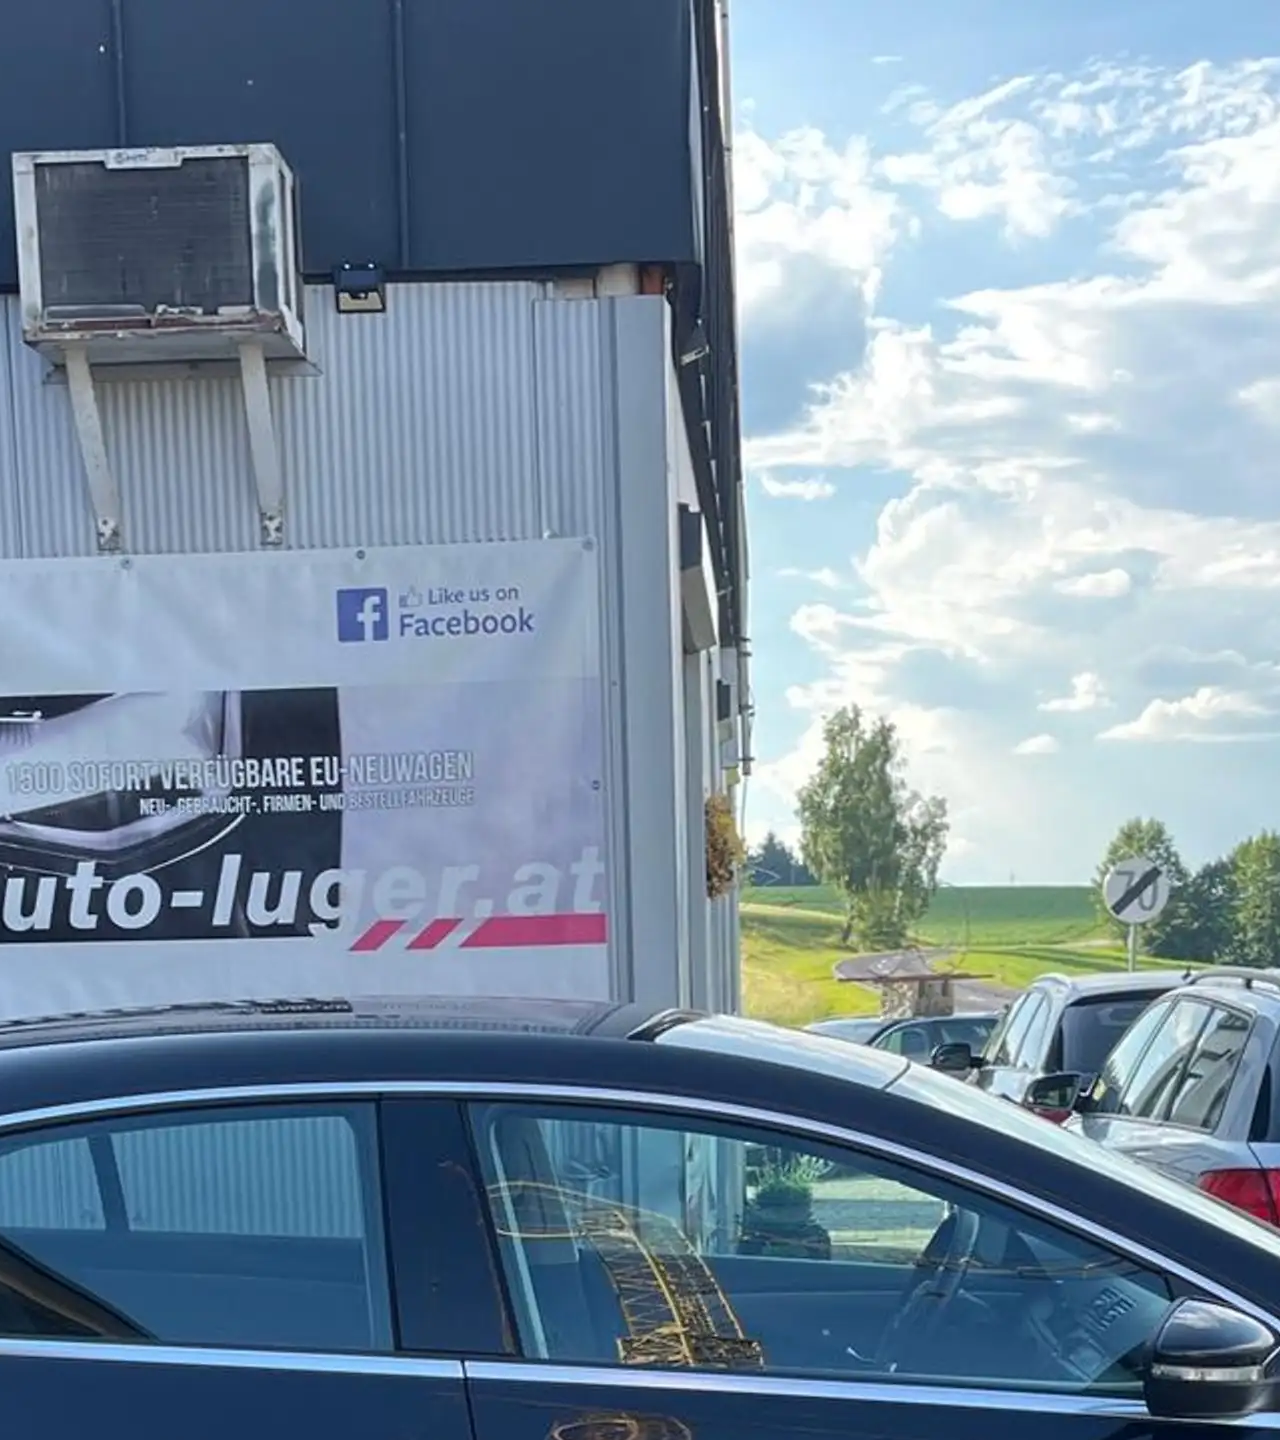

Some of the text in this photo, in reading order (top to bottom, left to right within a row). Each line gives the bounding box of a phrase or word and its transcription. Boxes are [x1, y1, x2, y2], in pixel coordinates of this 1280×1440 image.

[427, 587, 520, 605] Like us on
[399, 606, 535, 637] Facebook
[70, 760, 154, 793] SOFORT
[159, 754, 305, 791] VERFÜGBARE
[310, 751, 474, 787] EU-NEUWAGEN
[263, 793, 317, 812] FIRMEN-
[320, 793, 346, 811] UND
